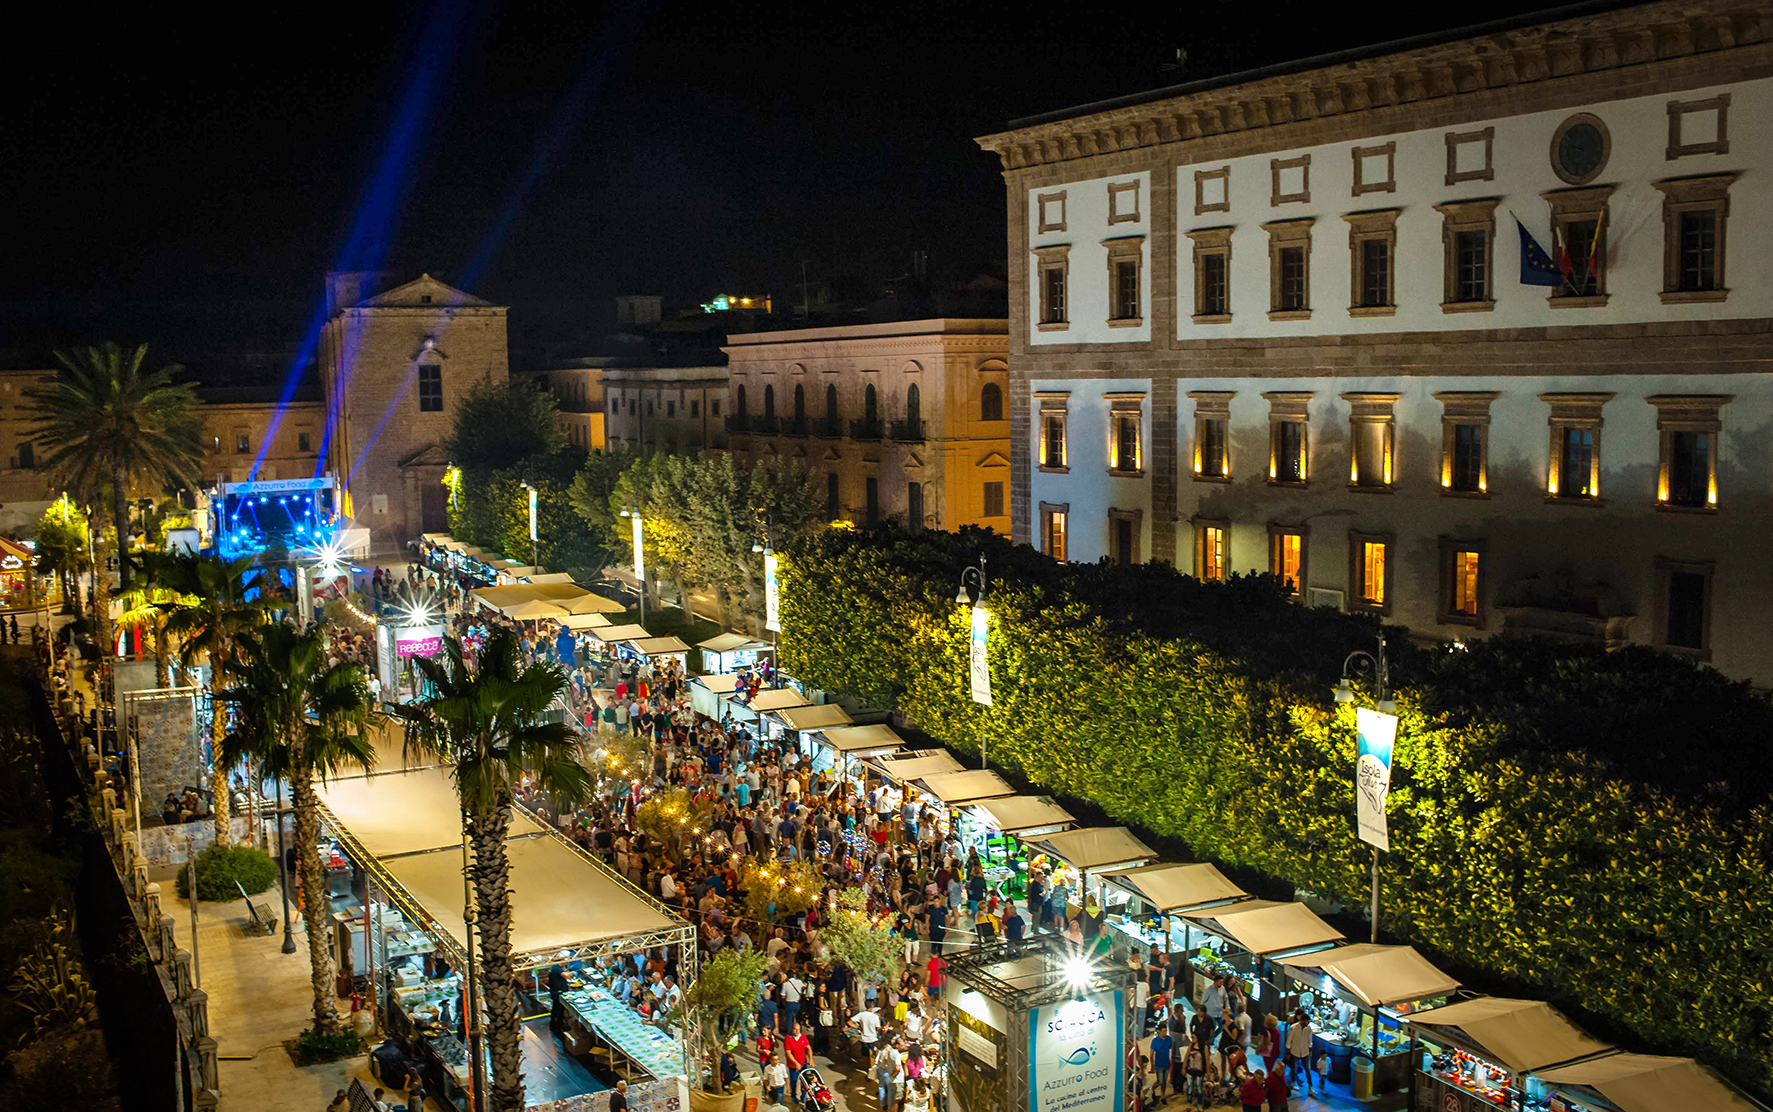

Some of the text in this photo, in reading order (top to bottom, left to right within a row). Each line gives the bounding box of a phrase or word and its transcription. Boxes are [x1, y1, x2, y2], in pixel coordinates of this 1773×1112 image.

[1361, 760, 1381, 778] Isola
[1043, 1066, 1108, 1091] Azzurro Food
[1045, 1098, 1055, 1106] La
[1061, 1094, 1106, 1110] Mediterraneo
